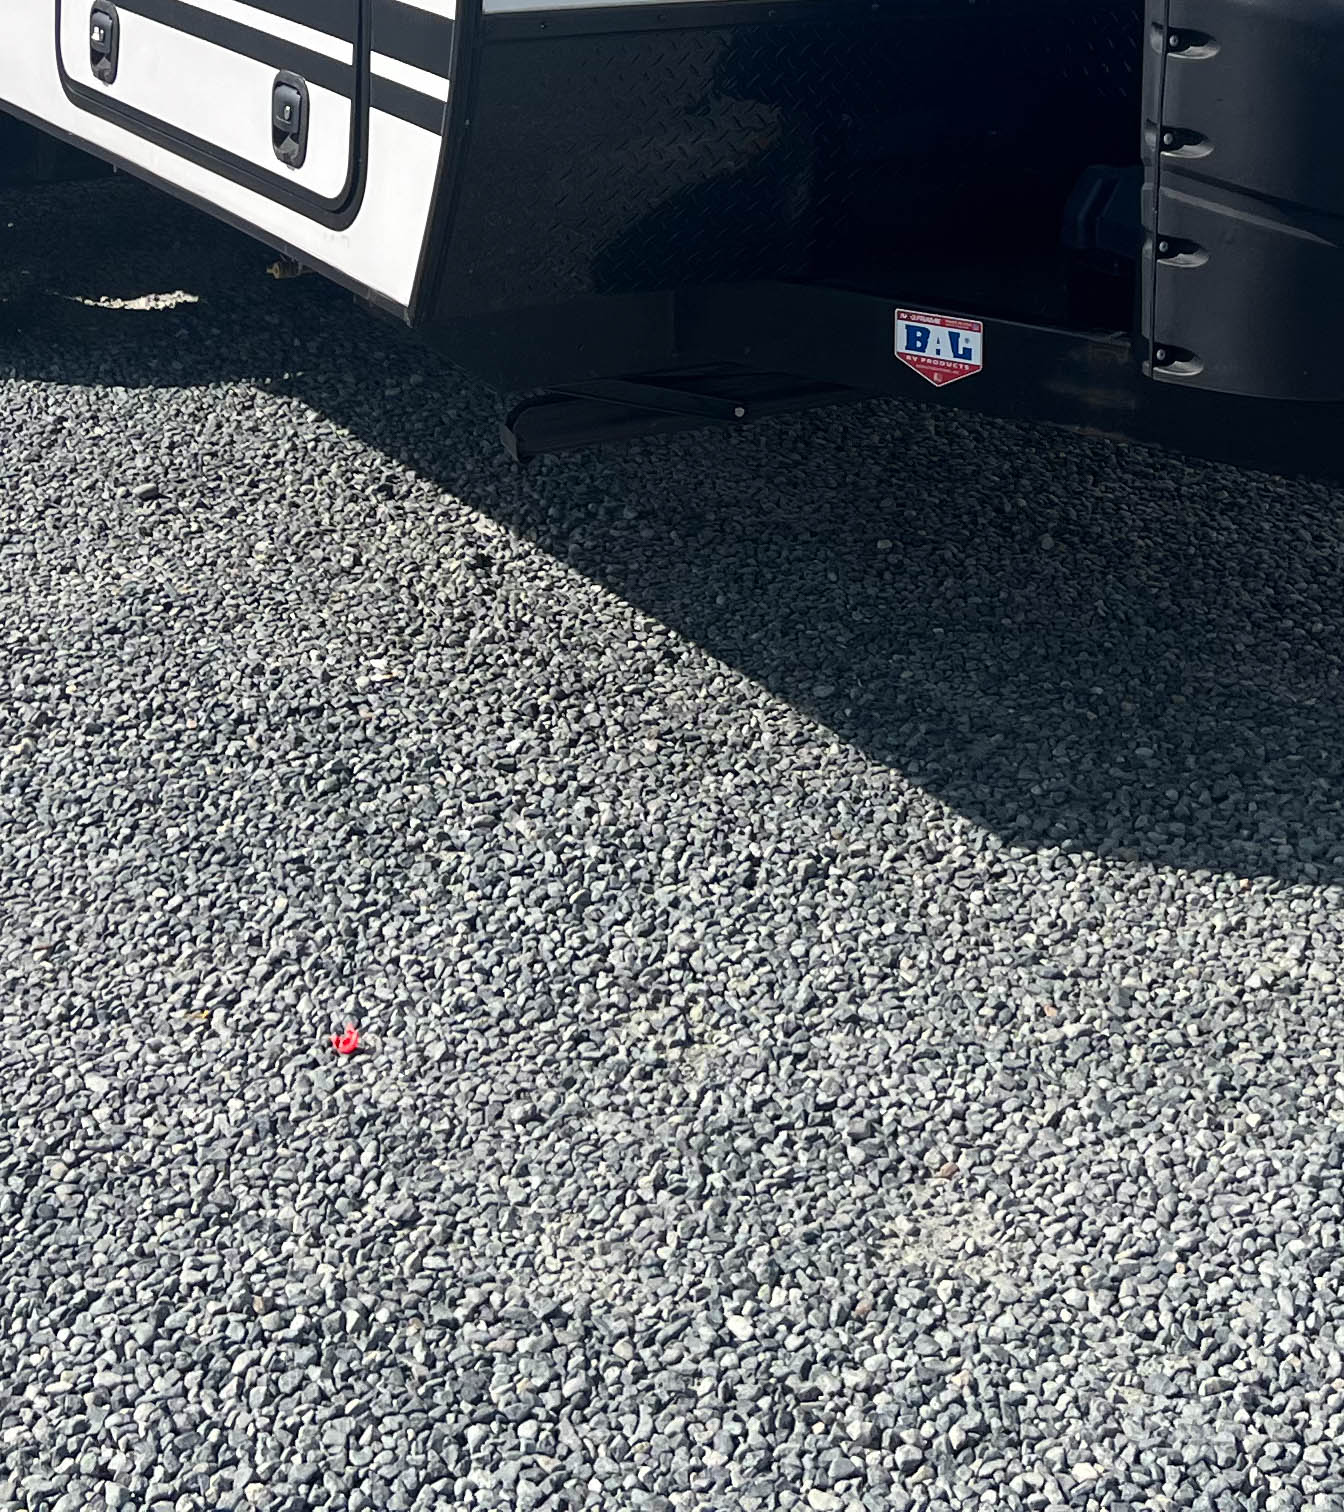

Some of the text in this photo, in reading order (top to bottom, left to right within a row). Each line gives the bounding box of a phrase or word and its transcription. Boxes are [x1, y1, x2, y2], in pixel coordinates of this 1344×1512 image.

[904, 324, 973, 361] BAL
[906, 354, 918, 362] RV
[920, 357, 970, 371] PRODUCTS
